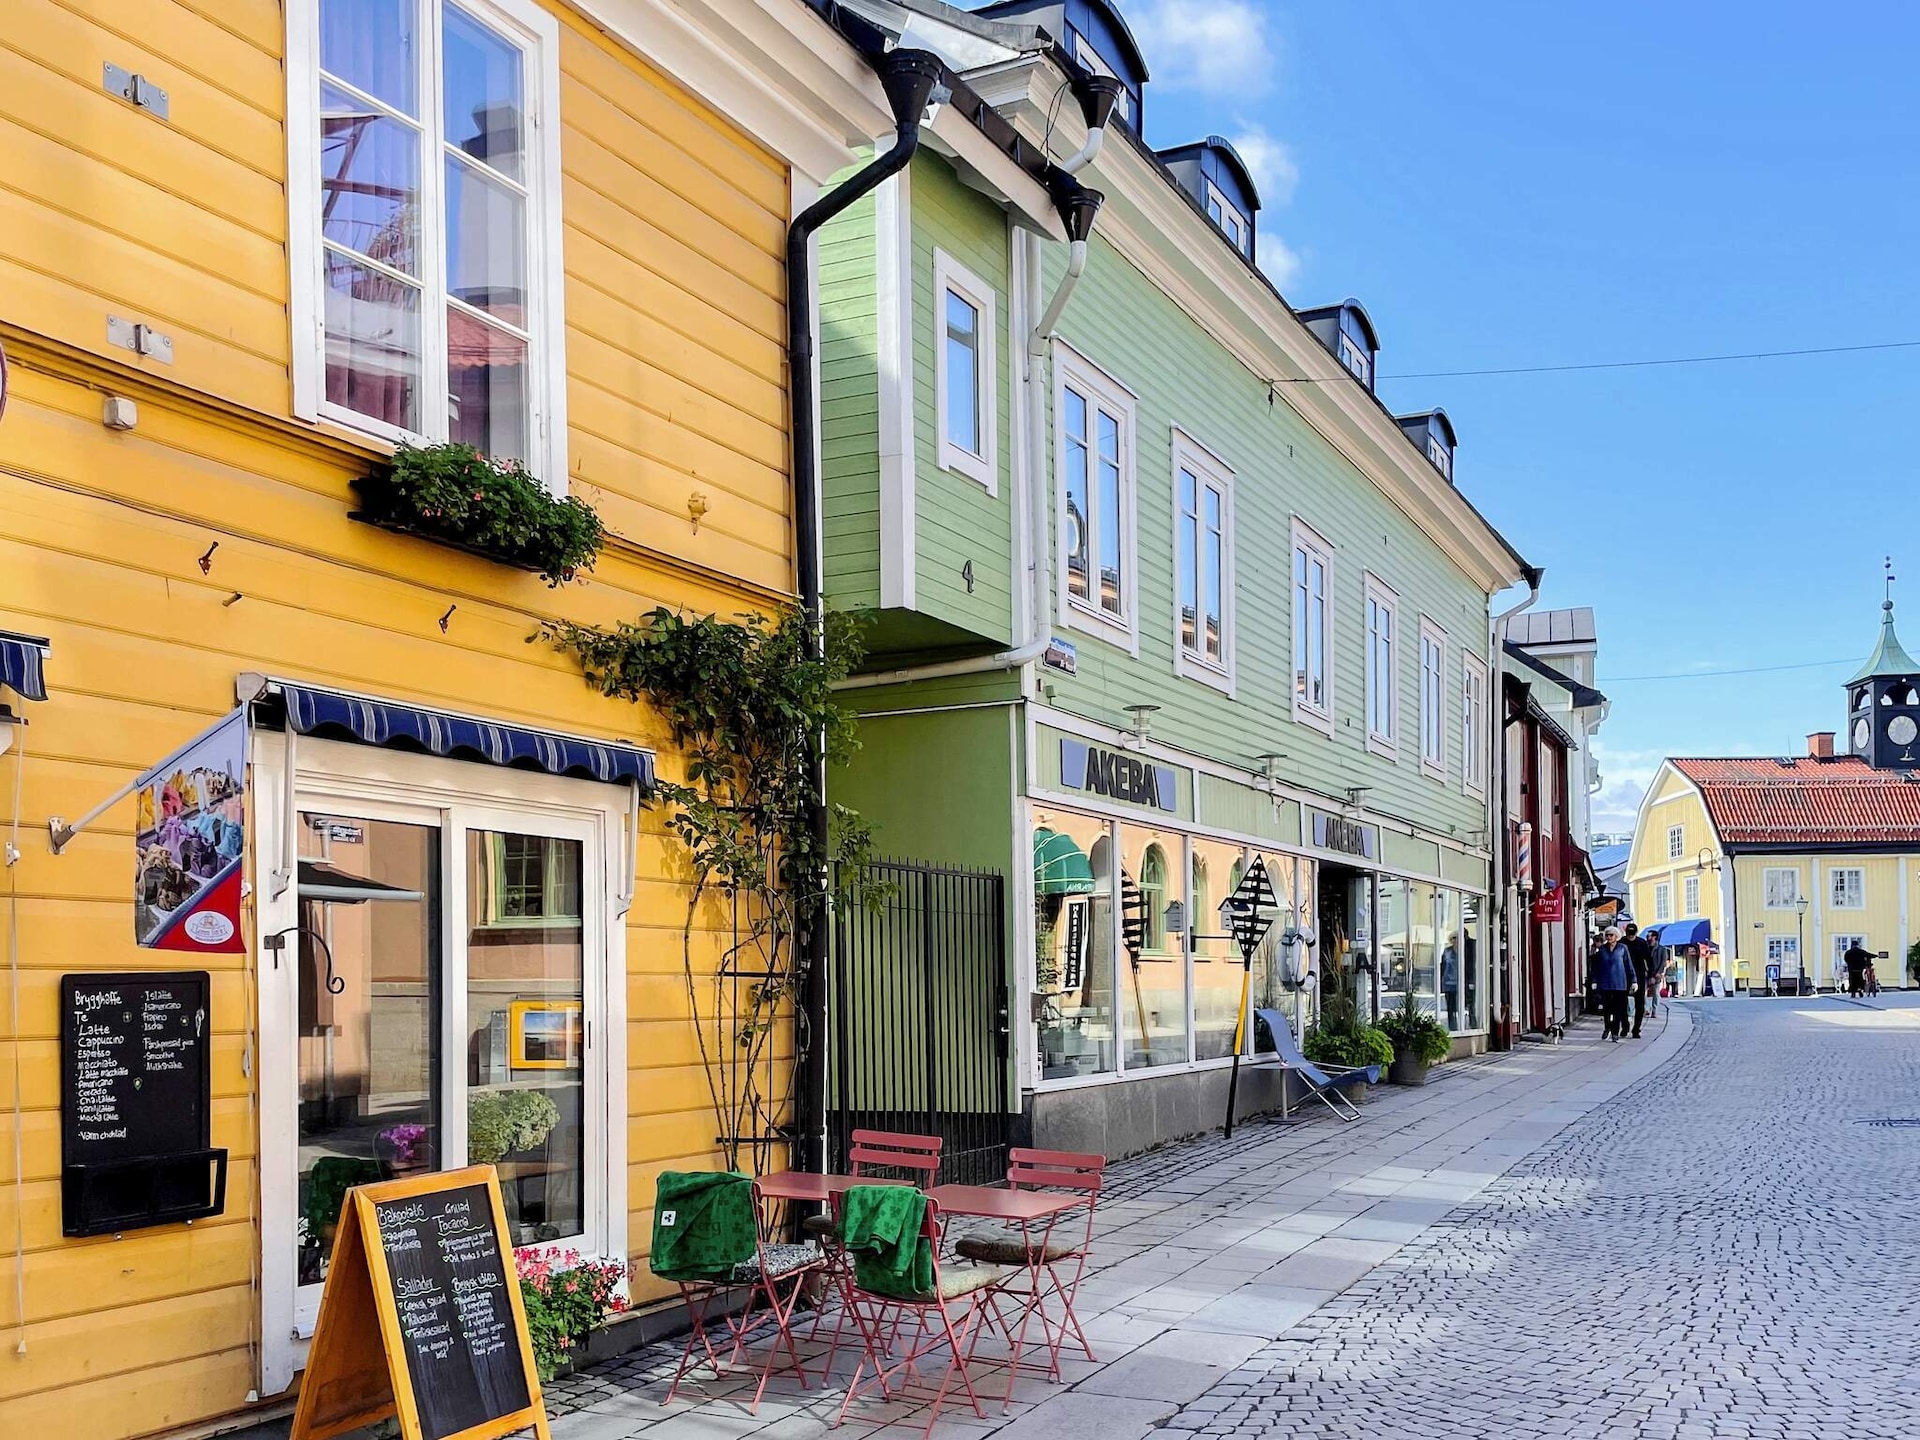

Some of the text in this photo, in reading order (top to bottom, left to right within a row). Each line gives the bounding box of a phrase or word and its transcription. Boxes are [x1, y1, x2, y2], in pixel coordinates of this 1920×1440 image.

[962, 560, 974, 593] 4
[1086, 747, 1156, 807] AKEBA
[1325, 817, 1363, 855] AKEBA
[1538, 898, 1559, 907] Drop
[74, 1010, 89, 1025] Te
[79, 1024, 111, 1036] Latte
